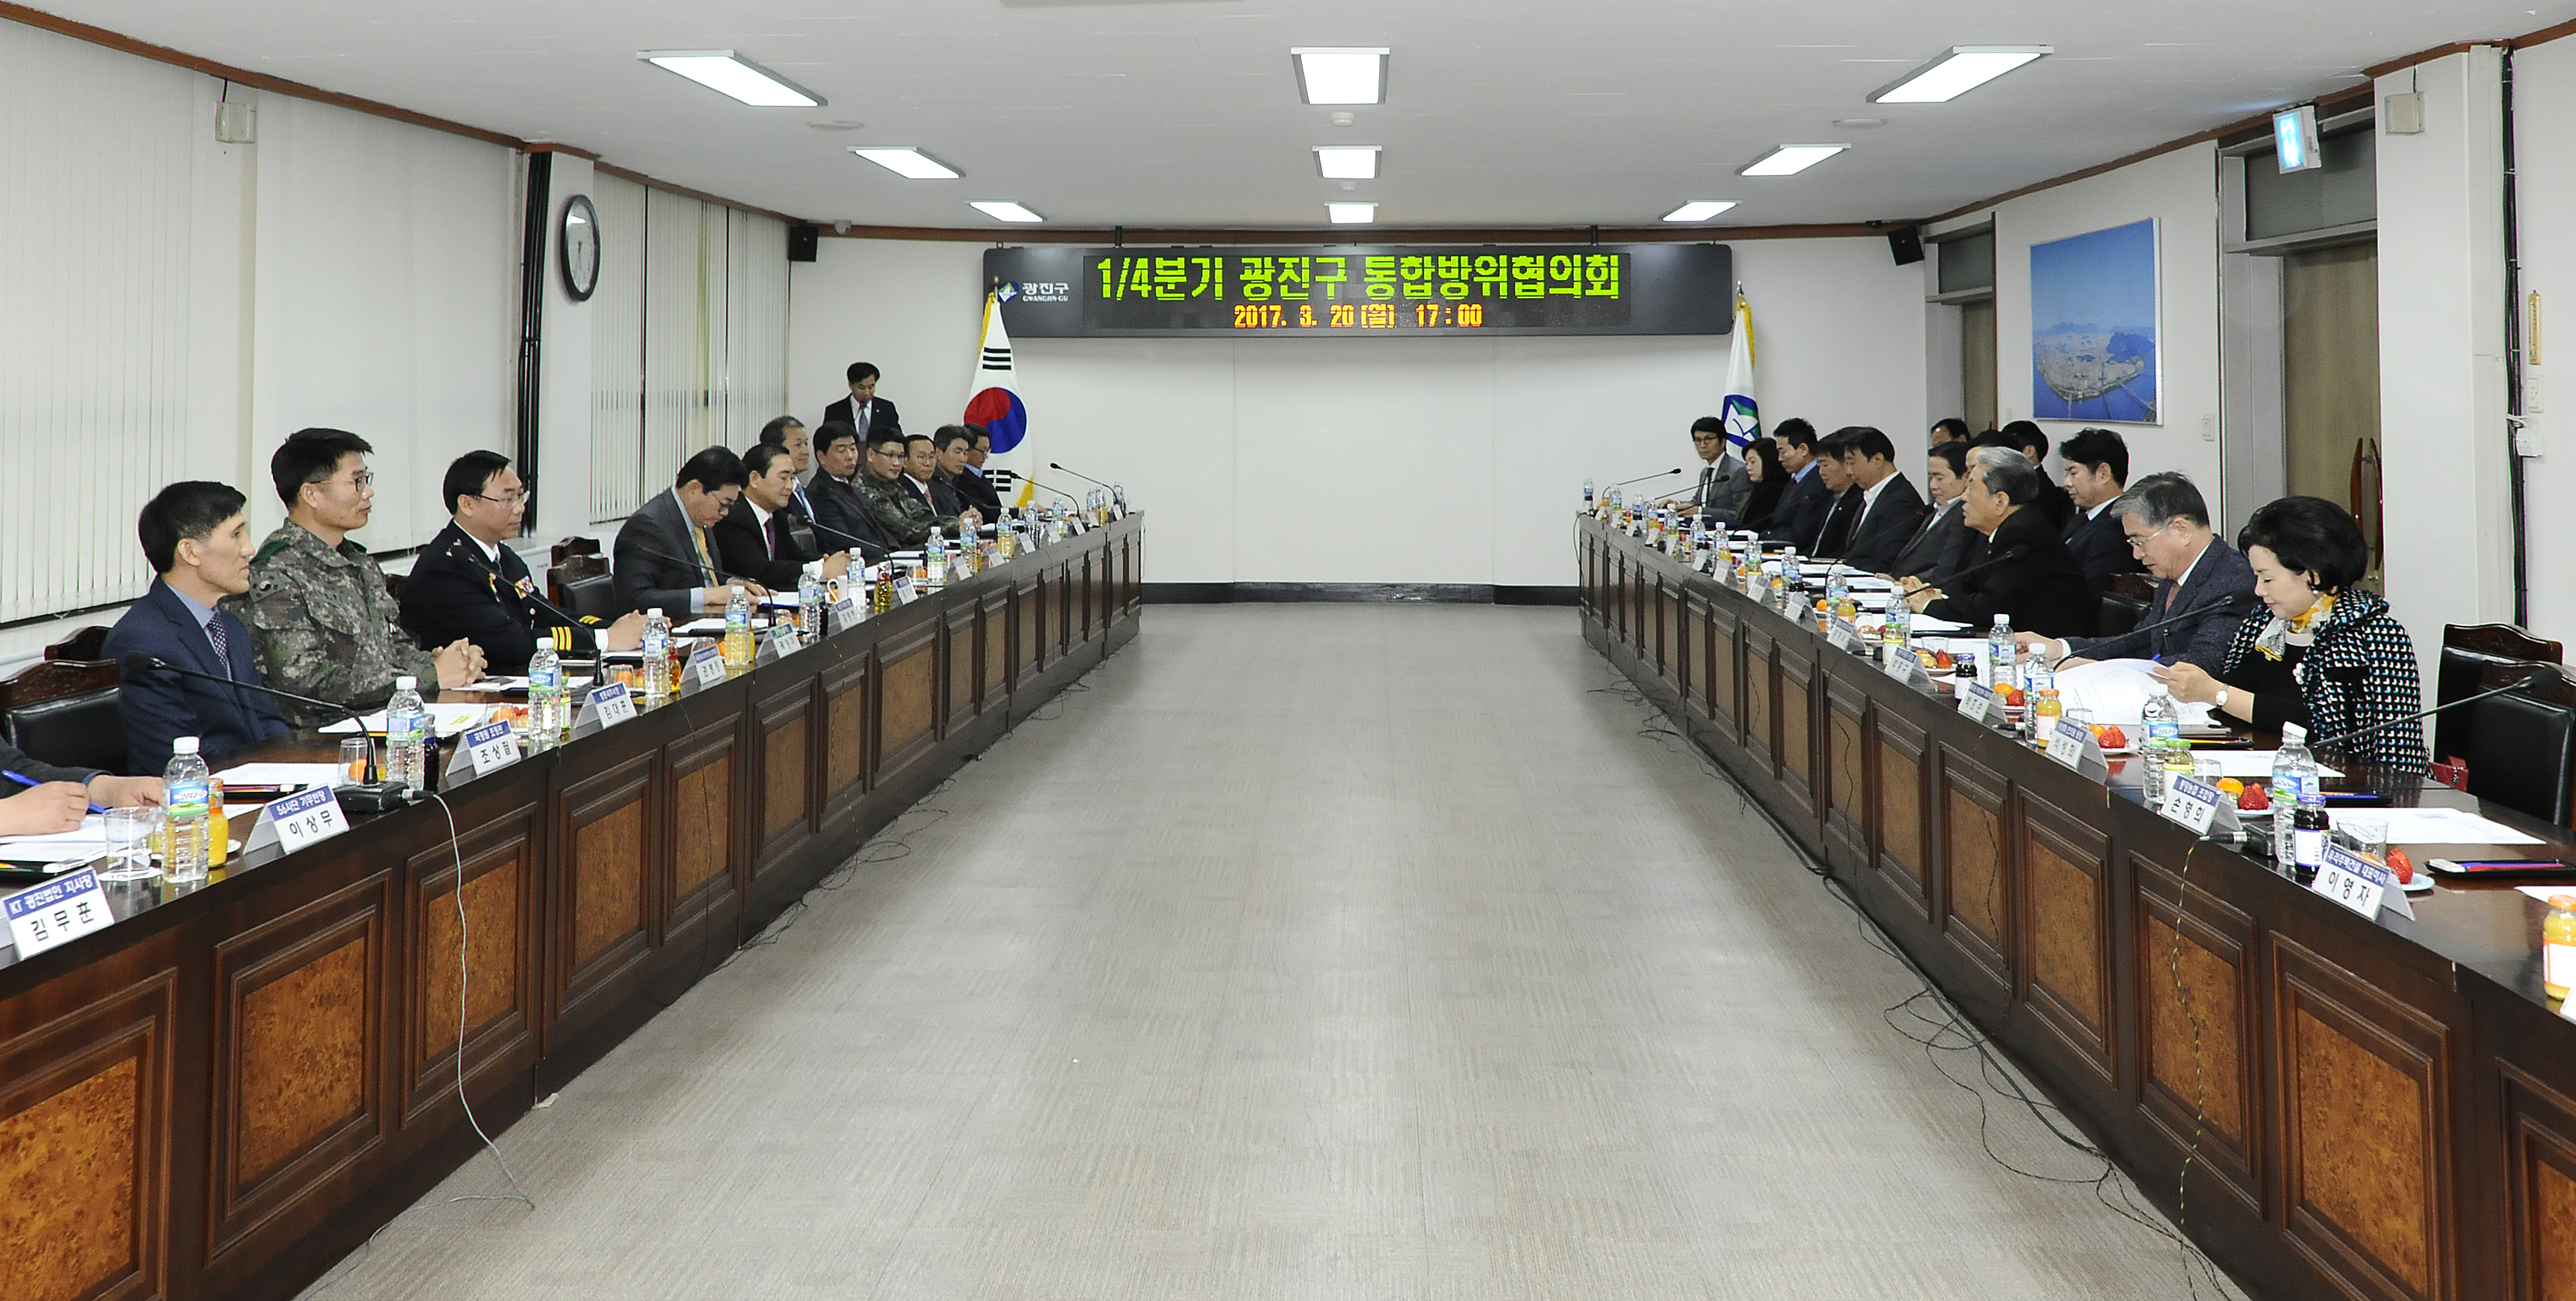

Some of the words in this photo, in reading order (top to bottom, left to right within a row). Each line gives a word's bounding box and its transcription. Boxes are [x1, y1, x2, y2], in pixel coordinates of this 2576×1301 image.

[1022, 282, 1070, 295] 광진구
[1097, 257, 1223, 301] 1/4분기
[1239, 257, 1347, 301] 광진구
[1363, 255, 1620, 300] 통합방위협의회
[1234, 304, 1287, 328] 2017.
[1299, 304, 1318, 328] 3.
[276, 799, 300, 817] 56사단
[289, 810, 333, 838] 이상무
[2327, 848, 2362, 875] 우리주택건설
[2360, 864, 2387, 885] 대표이사
[8, 899, 24, 915] KT
[24, 884, 64, 910] 광진법인
[63, 873, 94, 894] 지사장
[2327, 871, 2371, 907] 이영자
[31, 901, 95, 943] 김무훈
